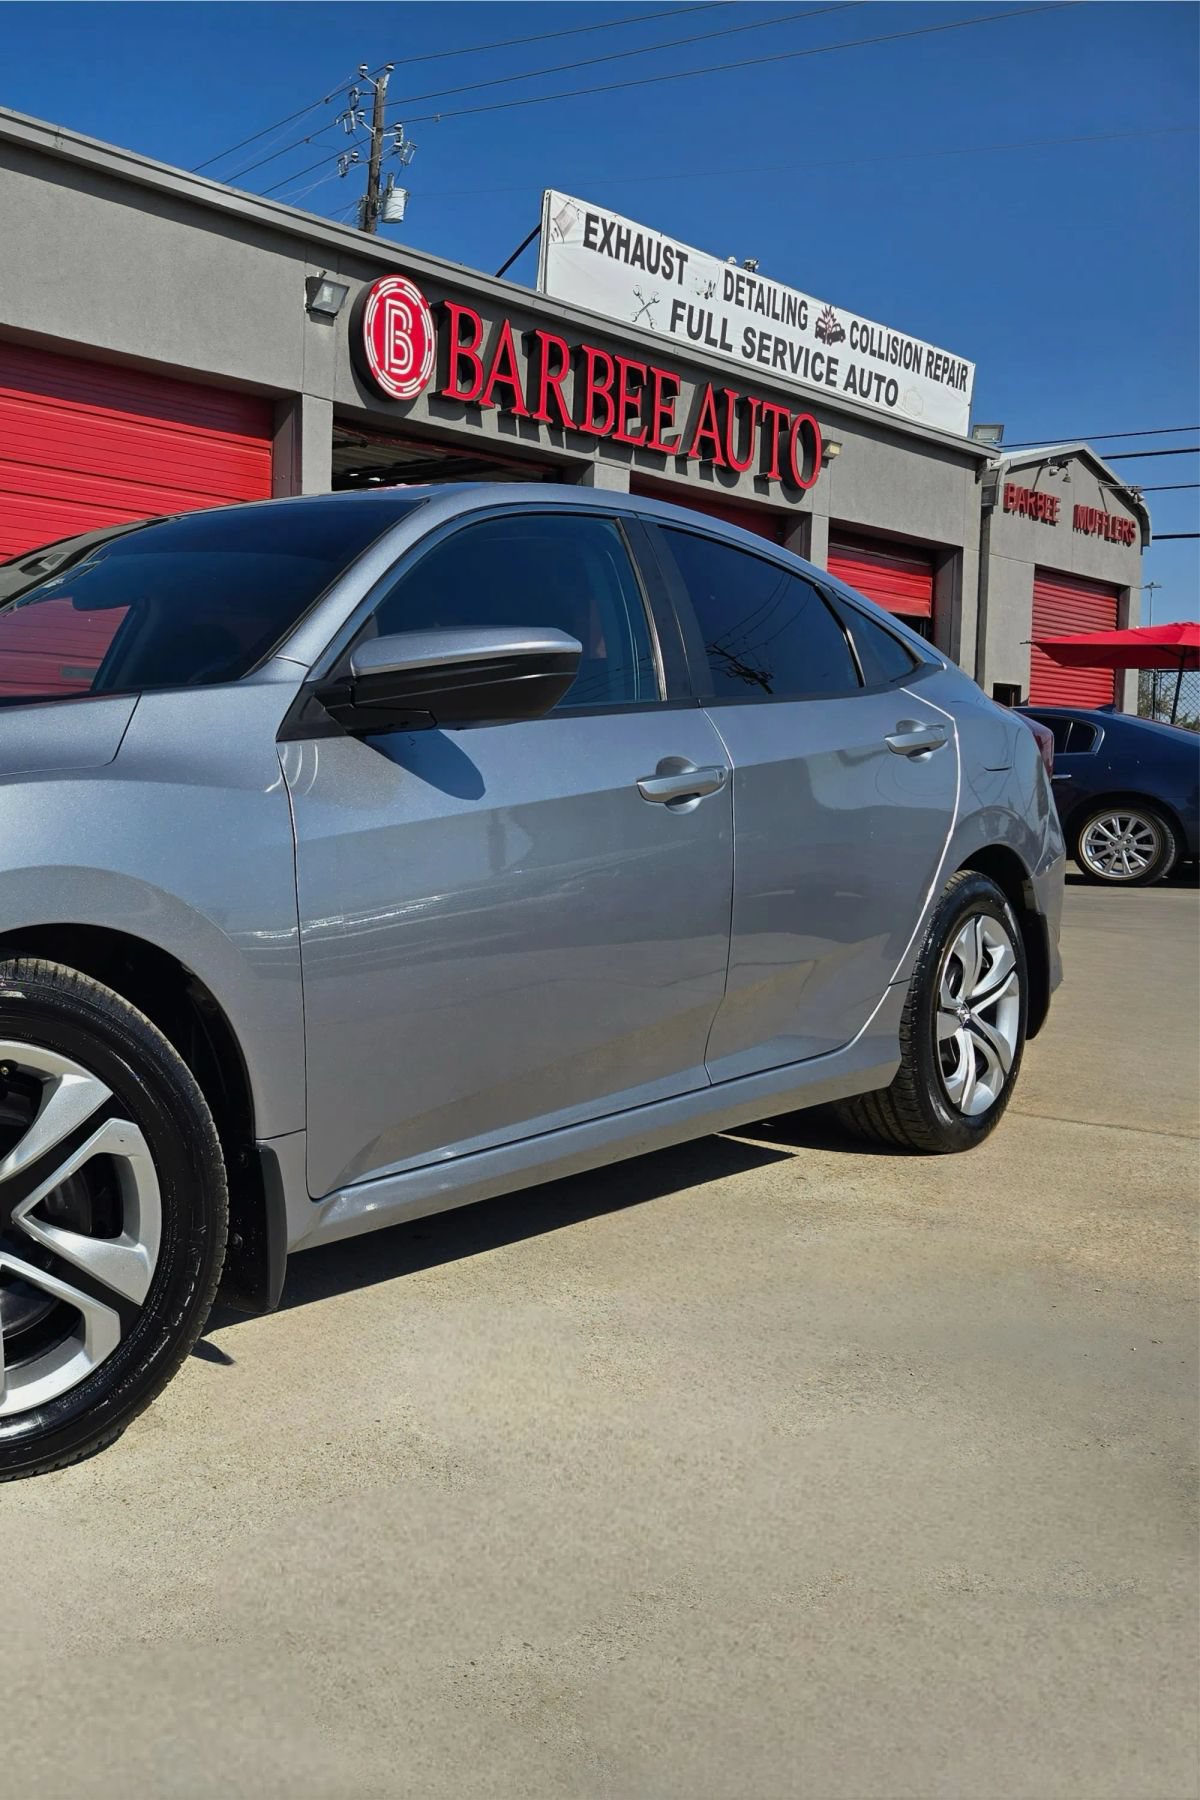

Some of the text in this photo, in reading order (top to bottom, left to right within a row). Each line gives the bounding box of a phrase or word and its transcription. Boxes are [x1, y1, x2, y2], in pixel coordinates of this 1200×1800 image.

[583, 212, 969, 392] EXHAUST DETAILING COLLISION REPAIR
[669, 298, 899, 407] FULL SERVICE AUTO
[442, 300, 822, 490] BARBEE AUTO
[1003, 483, 1137, 544] BARBEE MUFFLERS
